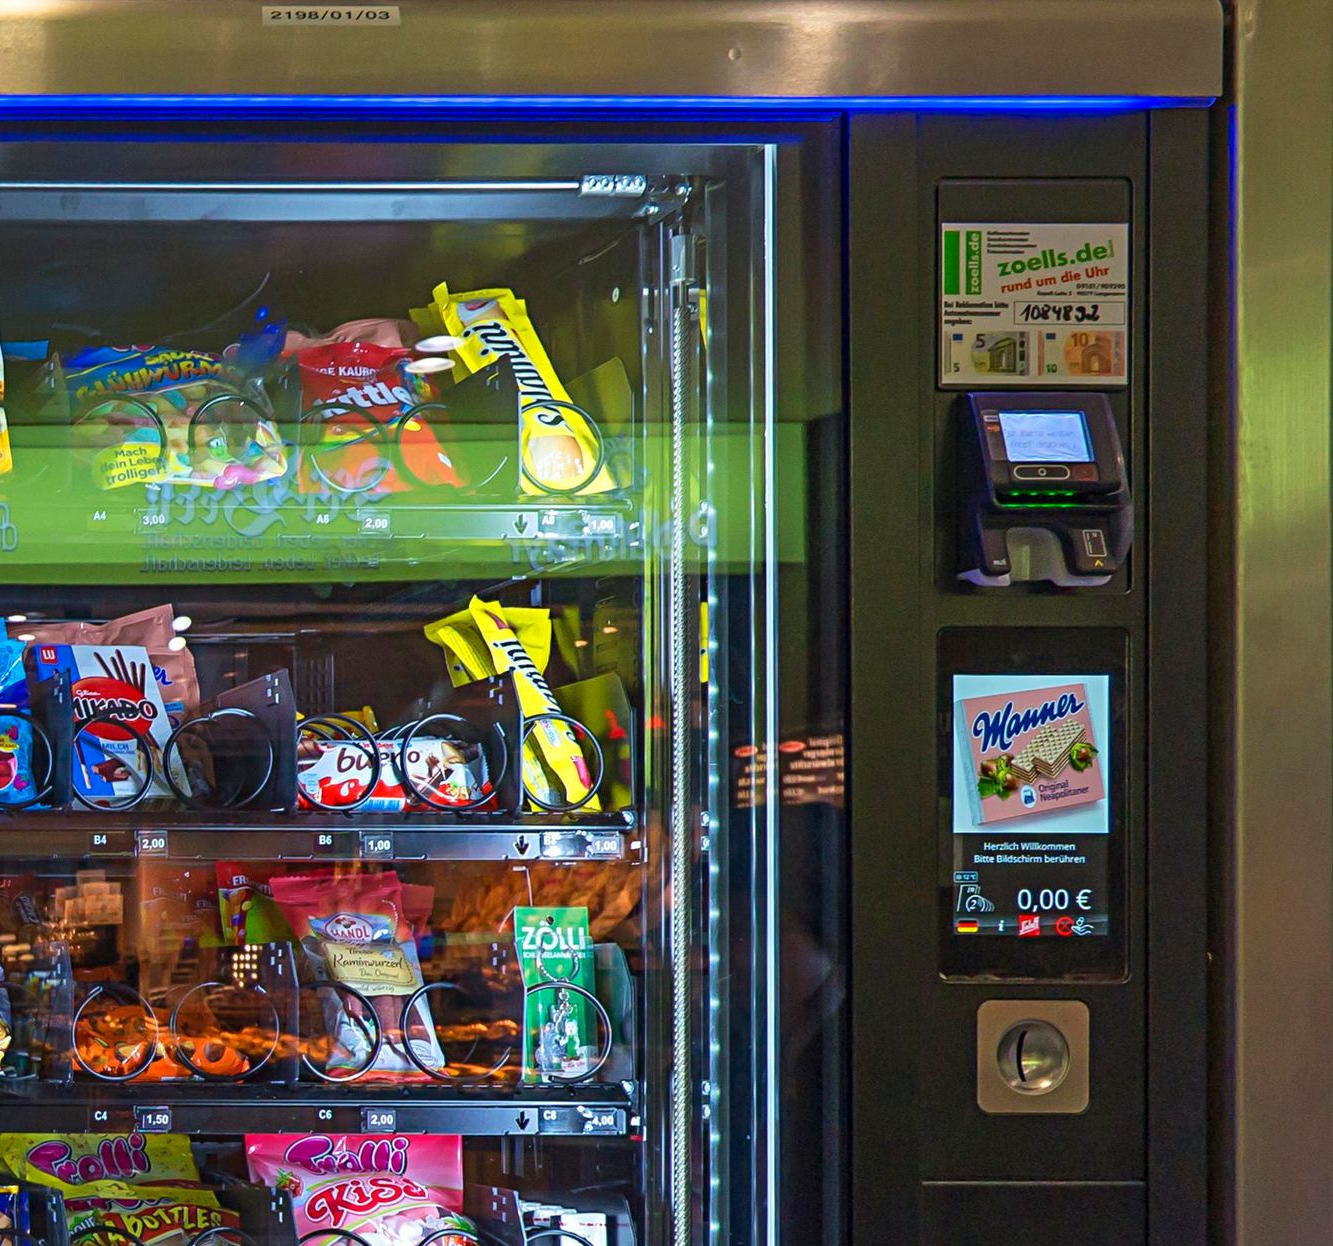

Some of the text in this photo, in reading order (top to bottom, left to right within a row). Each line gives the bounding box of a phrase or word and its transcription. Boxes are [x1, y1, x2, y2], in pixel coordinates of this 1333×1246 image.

[270, 10, 390, 20] 2198/01/03
[997, 241, 1108, 277] zoells.de
[1001, 278, 1033, 294] rund
[1036, 276, 1057, 287] um
[1061, 270, 1081, 283] die
[1085, 266, 1110, 278] Uhr
[973, 692, 1084, 753] Manner
[1039, 780, 1069, 793] Original
[1041, 785, 1089, 802] Neapolitaner
[319, 836, 391, 851] B6 1,00
[983, 842, 1075, 852] Herzlich Willkommen
[974, 854, 1085, 864] Bitte Bildschirm berühren
[1017, 888, 1092, 913] 0,00 €
[94, 1111, 169, 1126] C4 1,50
[27, 1133, 149, 1182] Trolli
[286, 1136, 409, 1176] Trolli
[125, 1206, 222, 1240] BOTTLES
